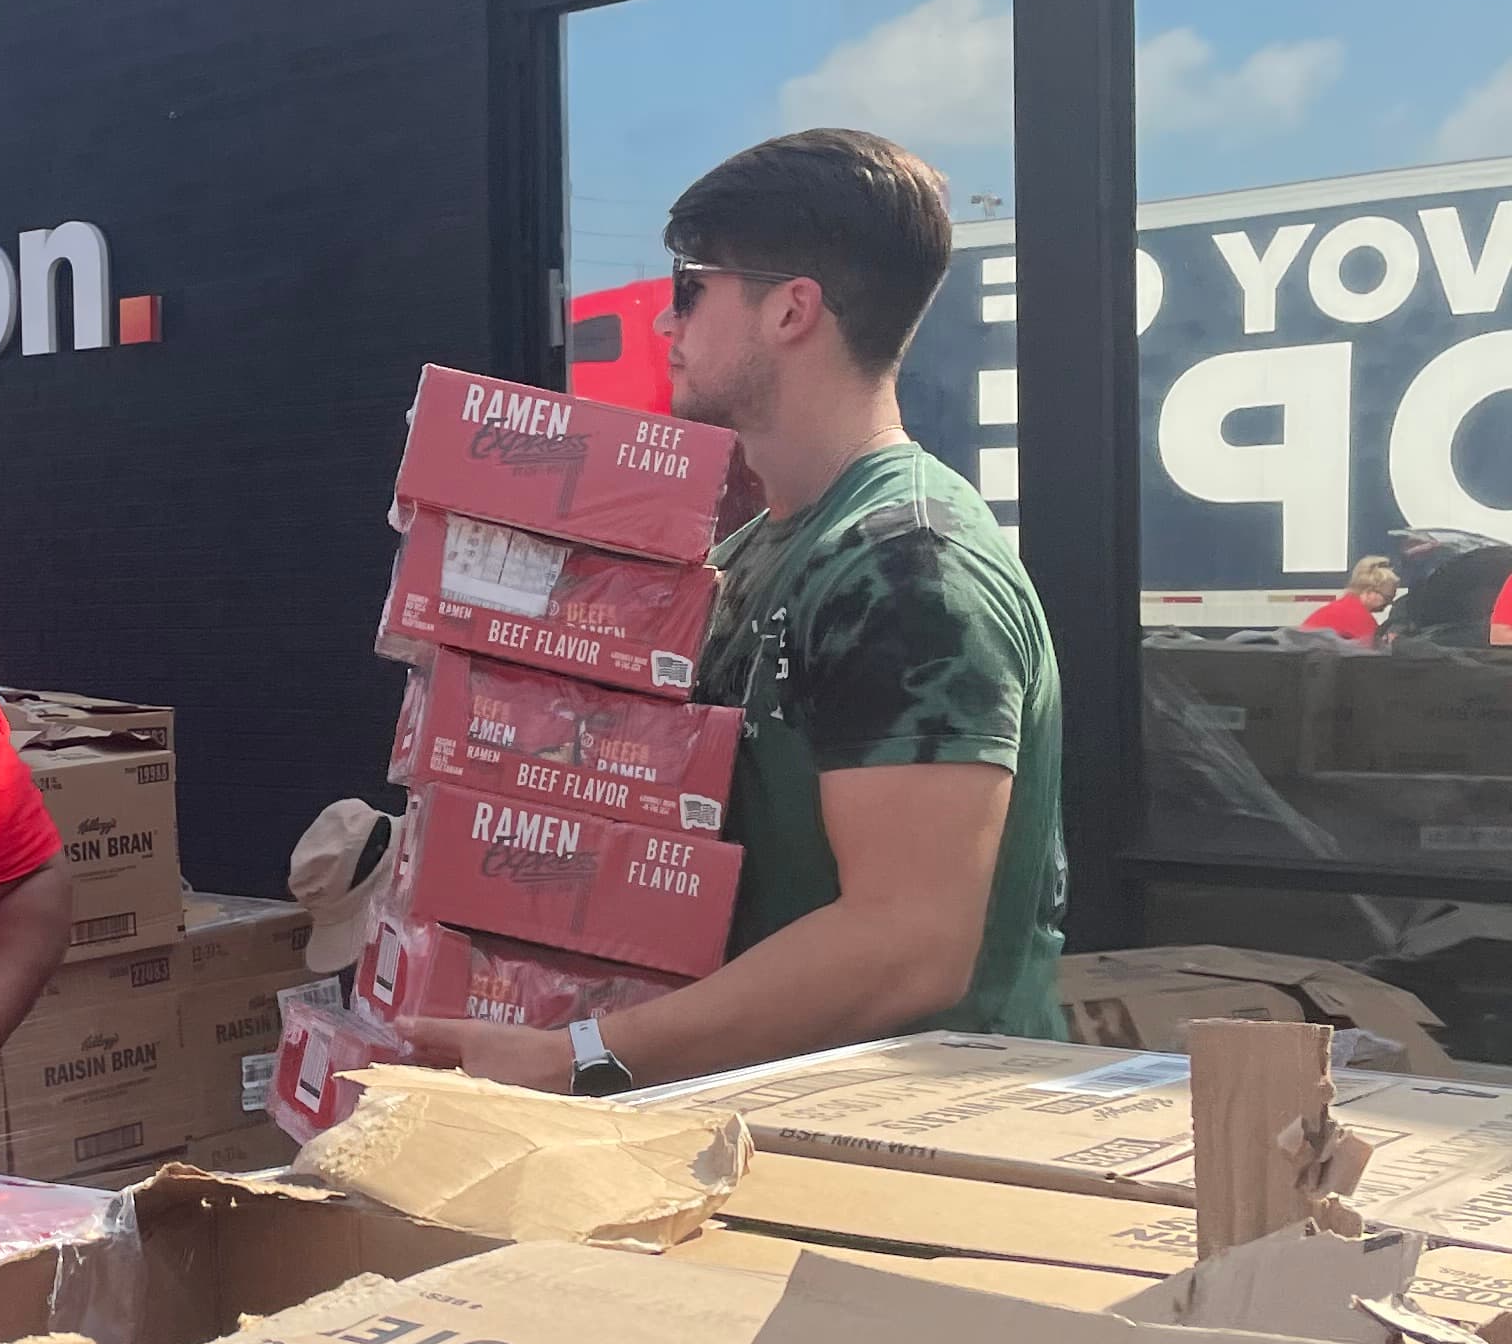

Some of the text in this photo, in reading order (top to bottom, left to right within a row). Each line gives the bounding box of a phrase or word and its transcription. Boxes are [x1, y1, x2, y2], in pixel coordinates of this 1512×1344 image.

[462, 383, 572, 442] RAMEN
[637, 421, 685, 449] BEEF
[617, 445, 689, 480] FLAVOR
[439, 602, 472, 619] RAMEN
[488, 619, 531, 650] BEEF
[534, 630, 600, 666] FLAVOR
[469, 717, 516, 746] AMEN
[466, 745, 500, 764] RAMEN
[517, 763, 560, 793] BEEF
[563, 772, 629, 809] FLAVOR
[107, 832, 153, 857] BRAN
[471, 802, 581, 860] RAMEN
[646, 838, 694, 868] BEEF
[628, 861, 700, 897] FLAVOR
[467, 996, 525, 1025] RAMEN
[215, 1017, 271, 1044] RAISIN
[44, 1042, 157, 1087] RAISIN BRAN
